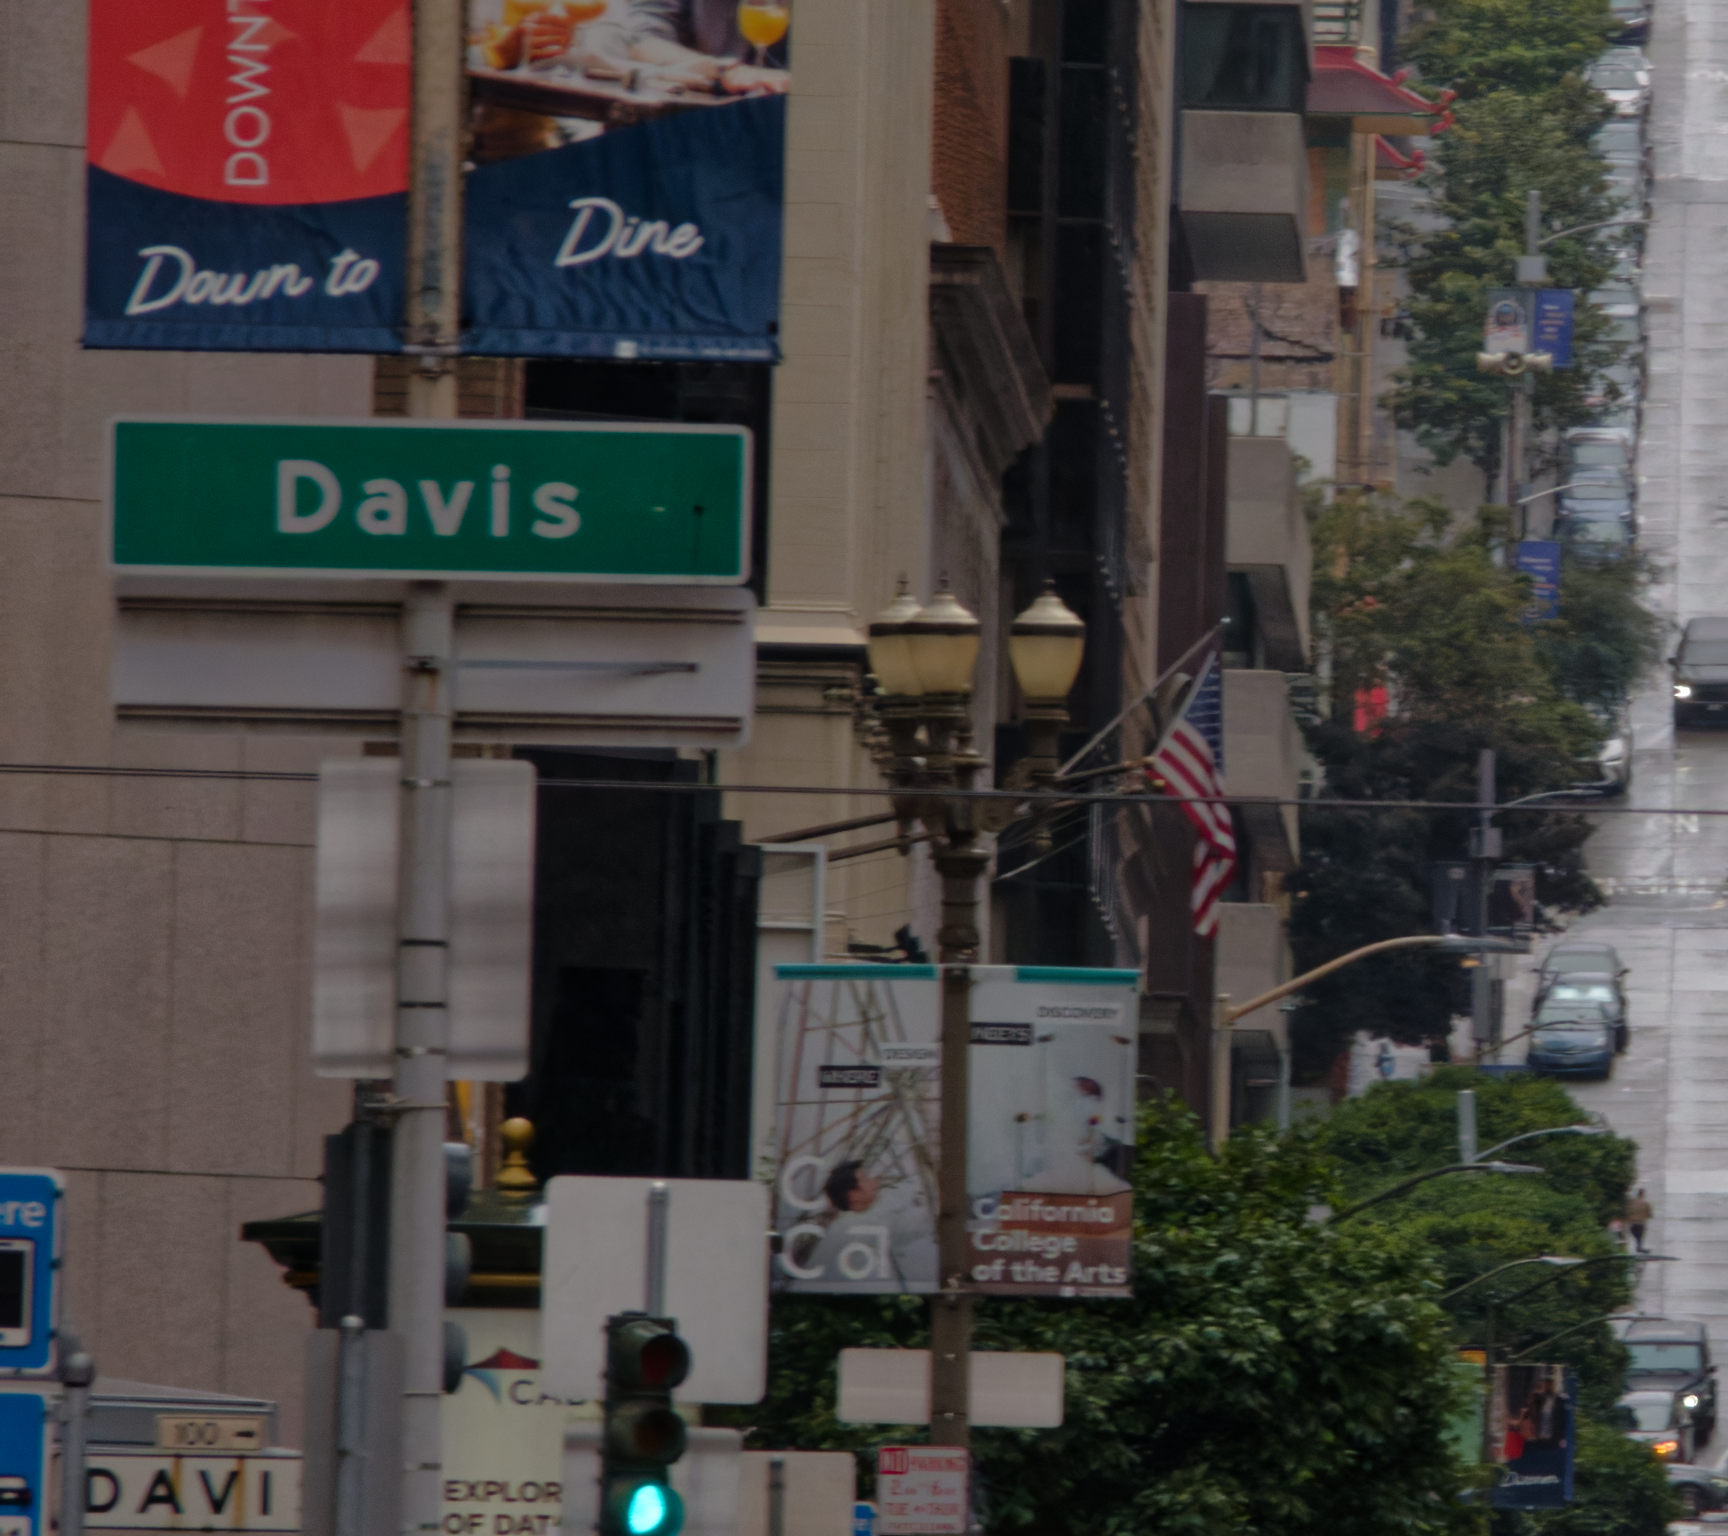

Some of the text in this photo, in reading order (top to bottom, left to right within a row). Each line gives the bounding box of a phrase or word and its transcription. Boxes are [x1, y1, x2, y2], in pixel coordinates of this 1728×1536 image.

[555, 197, 704, 267] Dine
[124, 245, 380, 316] Down to
[275, 459, 583, 539] Davis
[972, 1196, 1115, 1223] California
[971, 1229, 1077, 1258] College
[971, 1260, 1127, 1285] of the Arts
[442, 1514, 561, 1536] OF DAT
